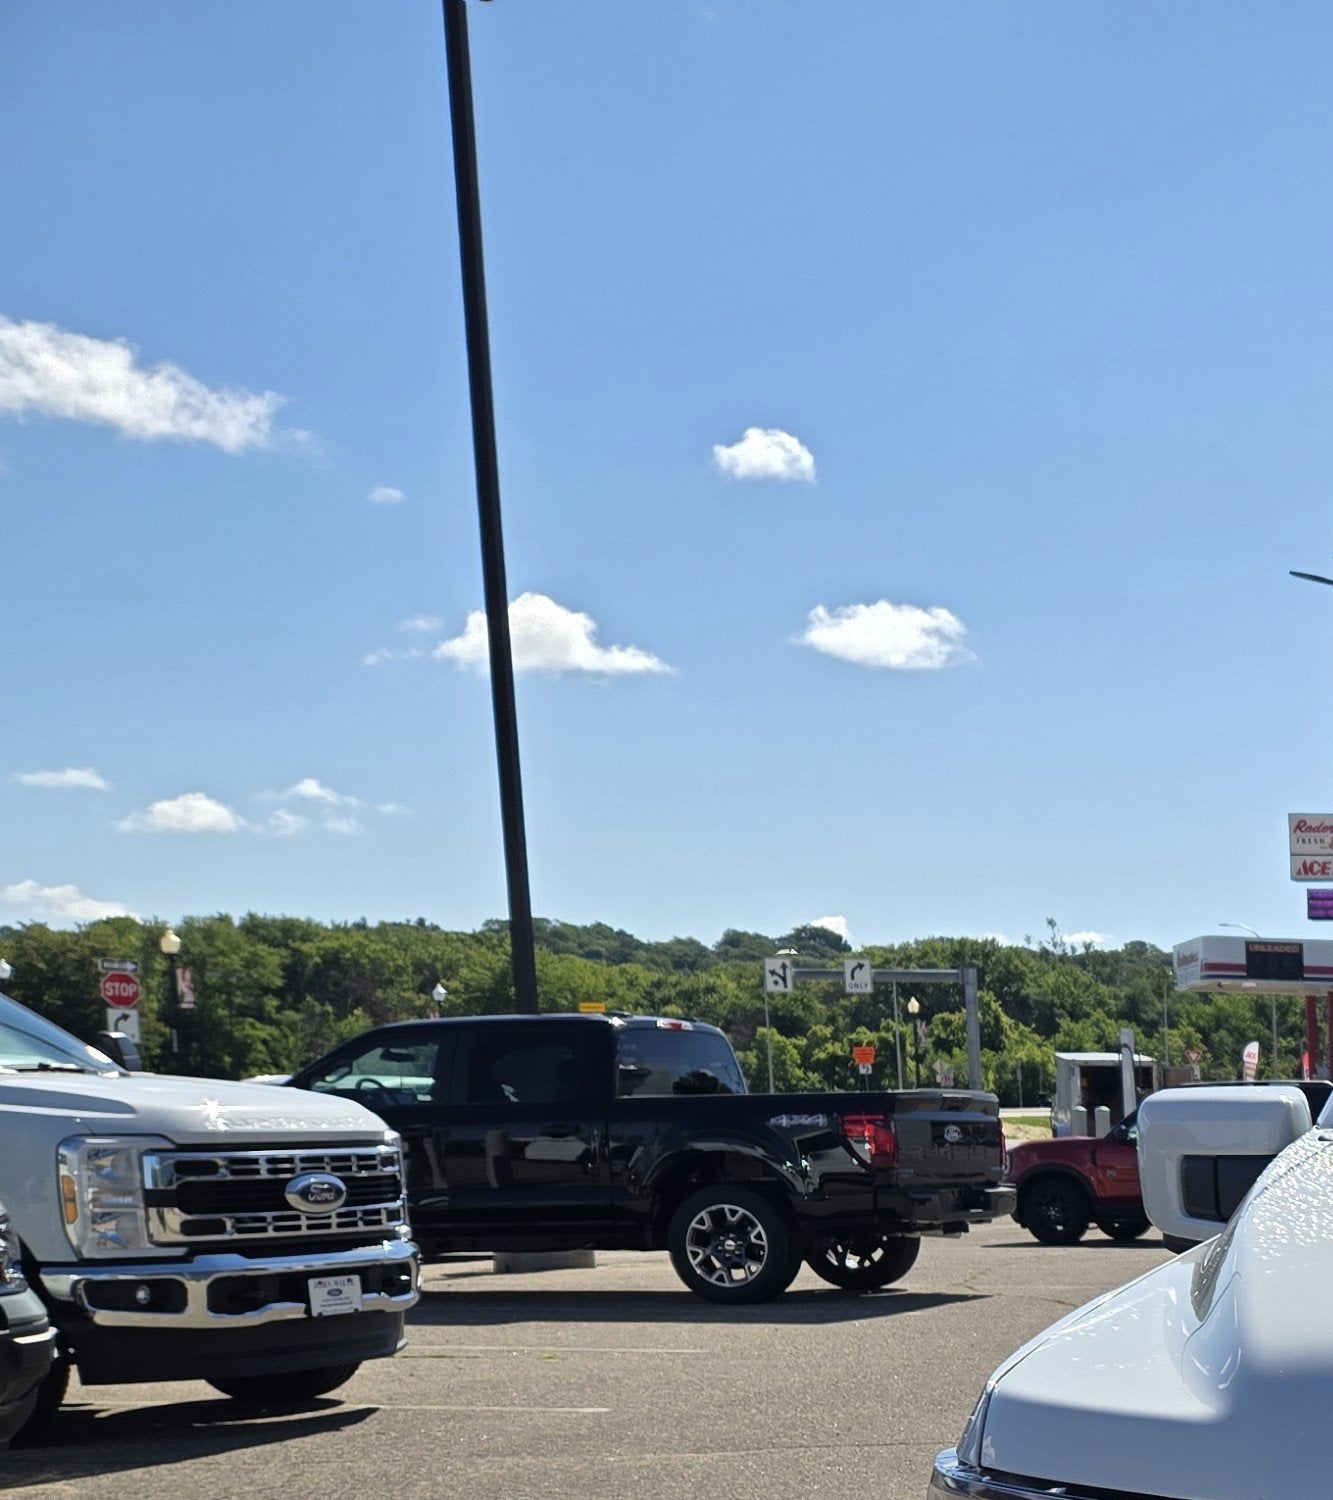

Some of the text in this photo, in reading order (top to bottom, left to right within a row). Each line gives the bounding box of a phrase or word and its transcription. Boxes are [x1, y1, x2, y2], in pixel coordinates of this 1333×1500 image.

[1295, 858, 1332, 876] ACE
[105, 981, 138, 997] STOP
[308, 1183, 336, 1202] Ford
